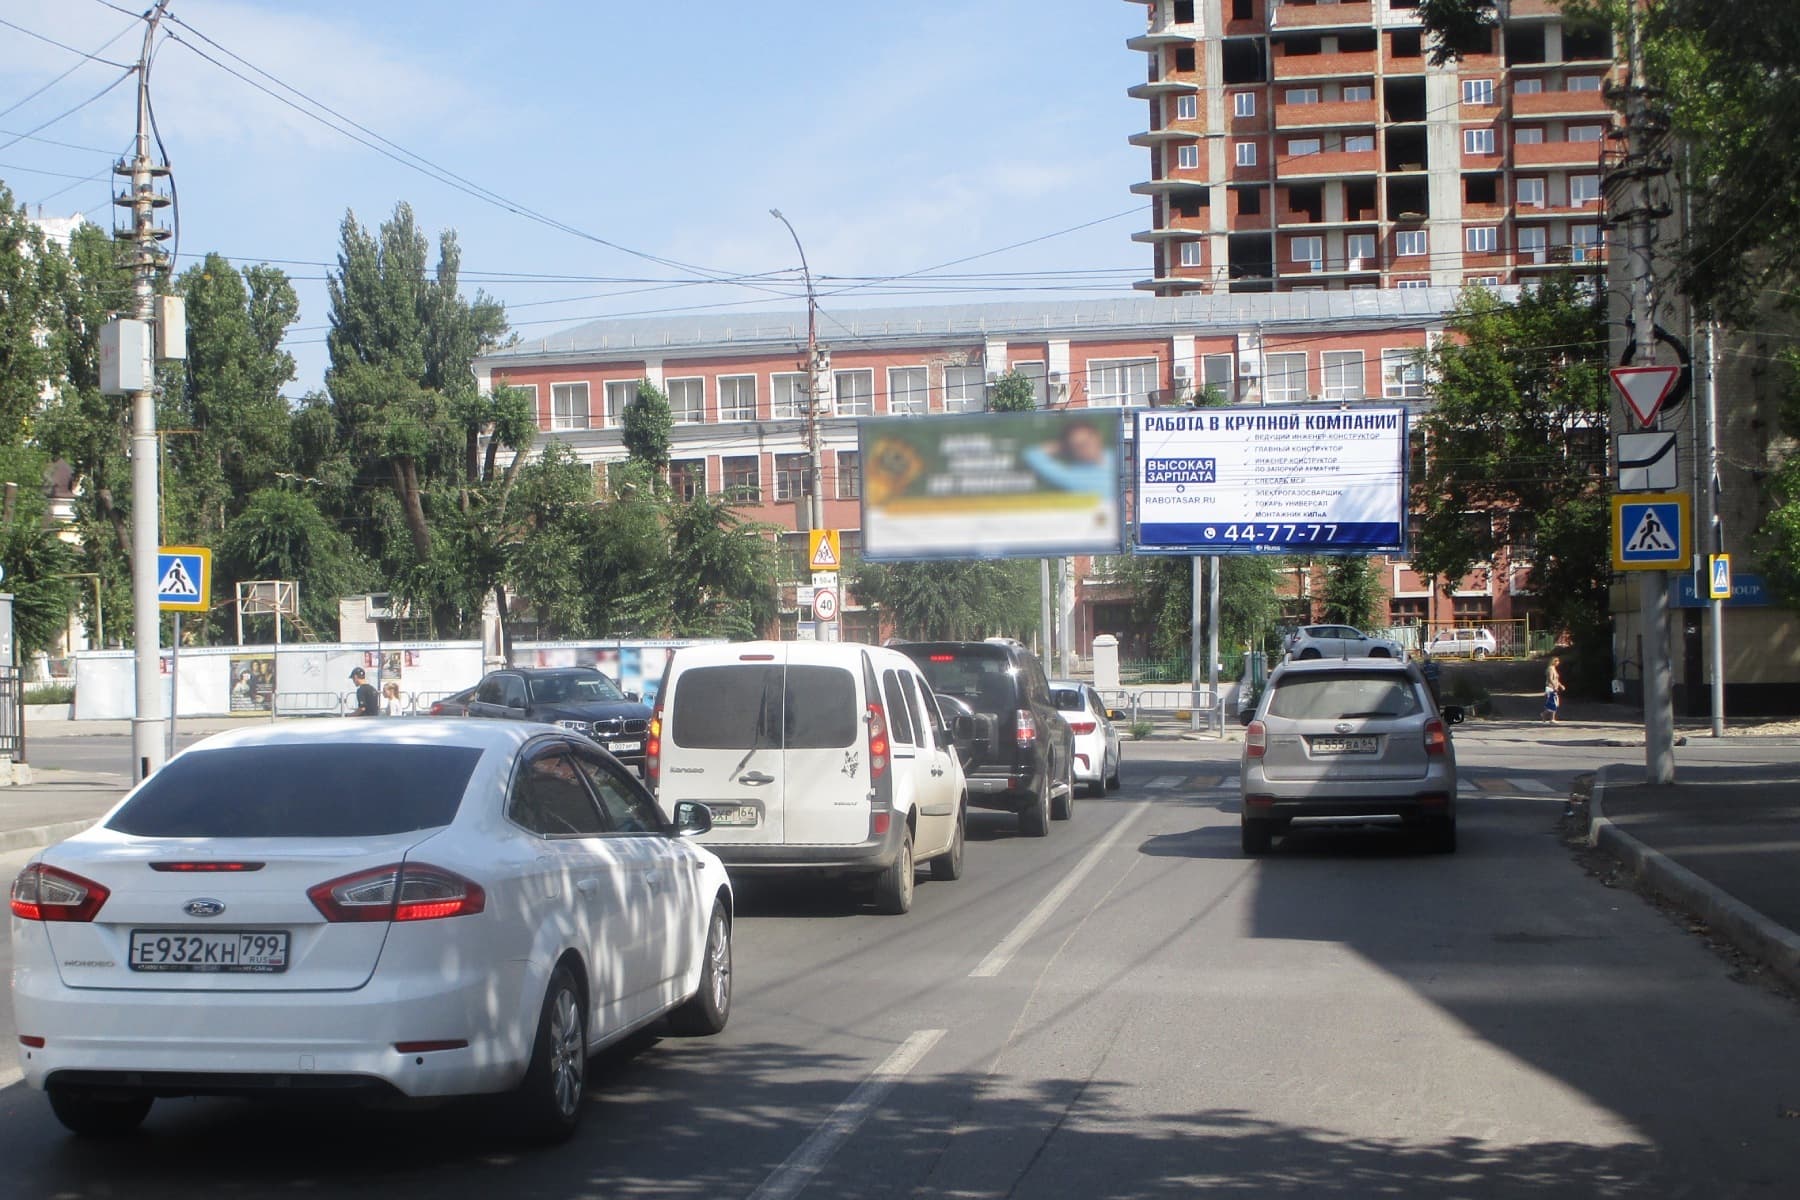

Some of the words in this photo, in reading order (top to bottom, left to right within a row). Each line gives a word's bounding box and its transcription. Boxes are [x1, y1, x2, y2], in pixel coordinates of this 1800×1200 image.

[1145, 416, 1204, 431] РАБОТА
[1210, 416, 1219, 431] В
[1225, 414, 1299, 431] КРУПНОЙ
[1305, 414, 1397, 430] КОМПАНИИ
[1254, 445, 1290, 453] ГЛАВНЫЙ
[1292, 445, 1343, 453] КОНСТРУКТОР
[1147, 460, 1213, 471] ВЫСОКАЯ
[1147, 471, 1213, 482] ЗАРПЛАТА
[1145, 496, 1216, 505] RABOTASAR.RU
[1224, 525, 1338, 542] 44-77-77
[820, 599, 833, 611] 40
[738, 807, 754, 817] 164
[141, 937, 235, 962] Е932КН
[242, 936, 279, 955] 799
